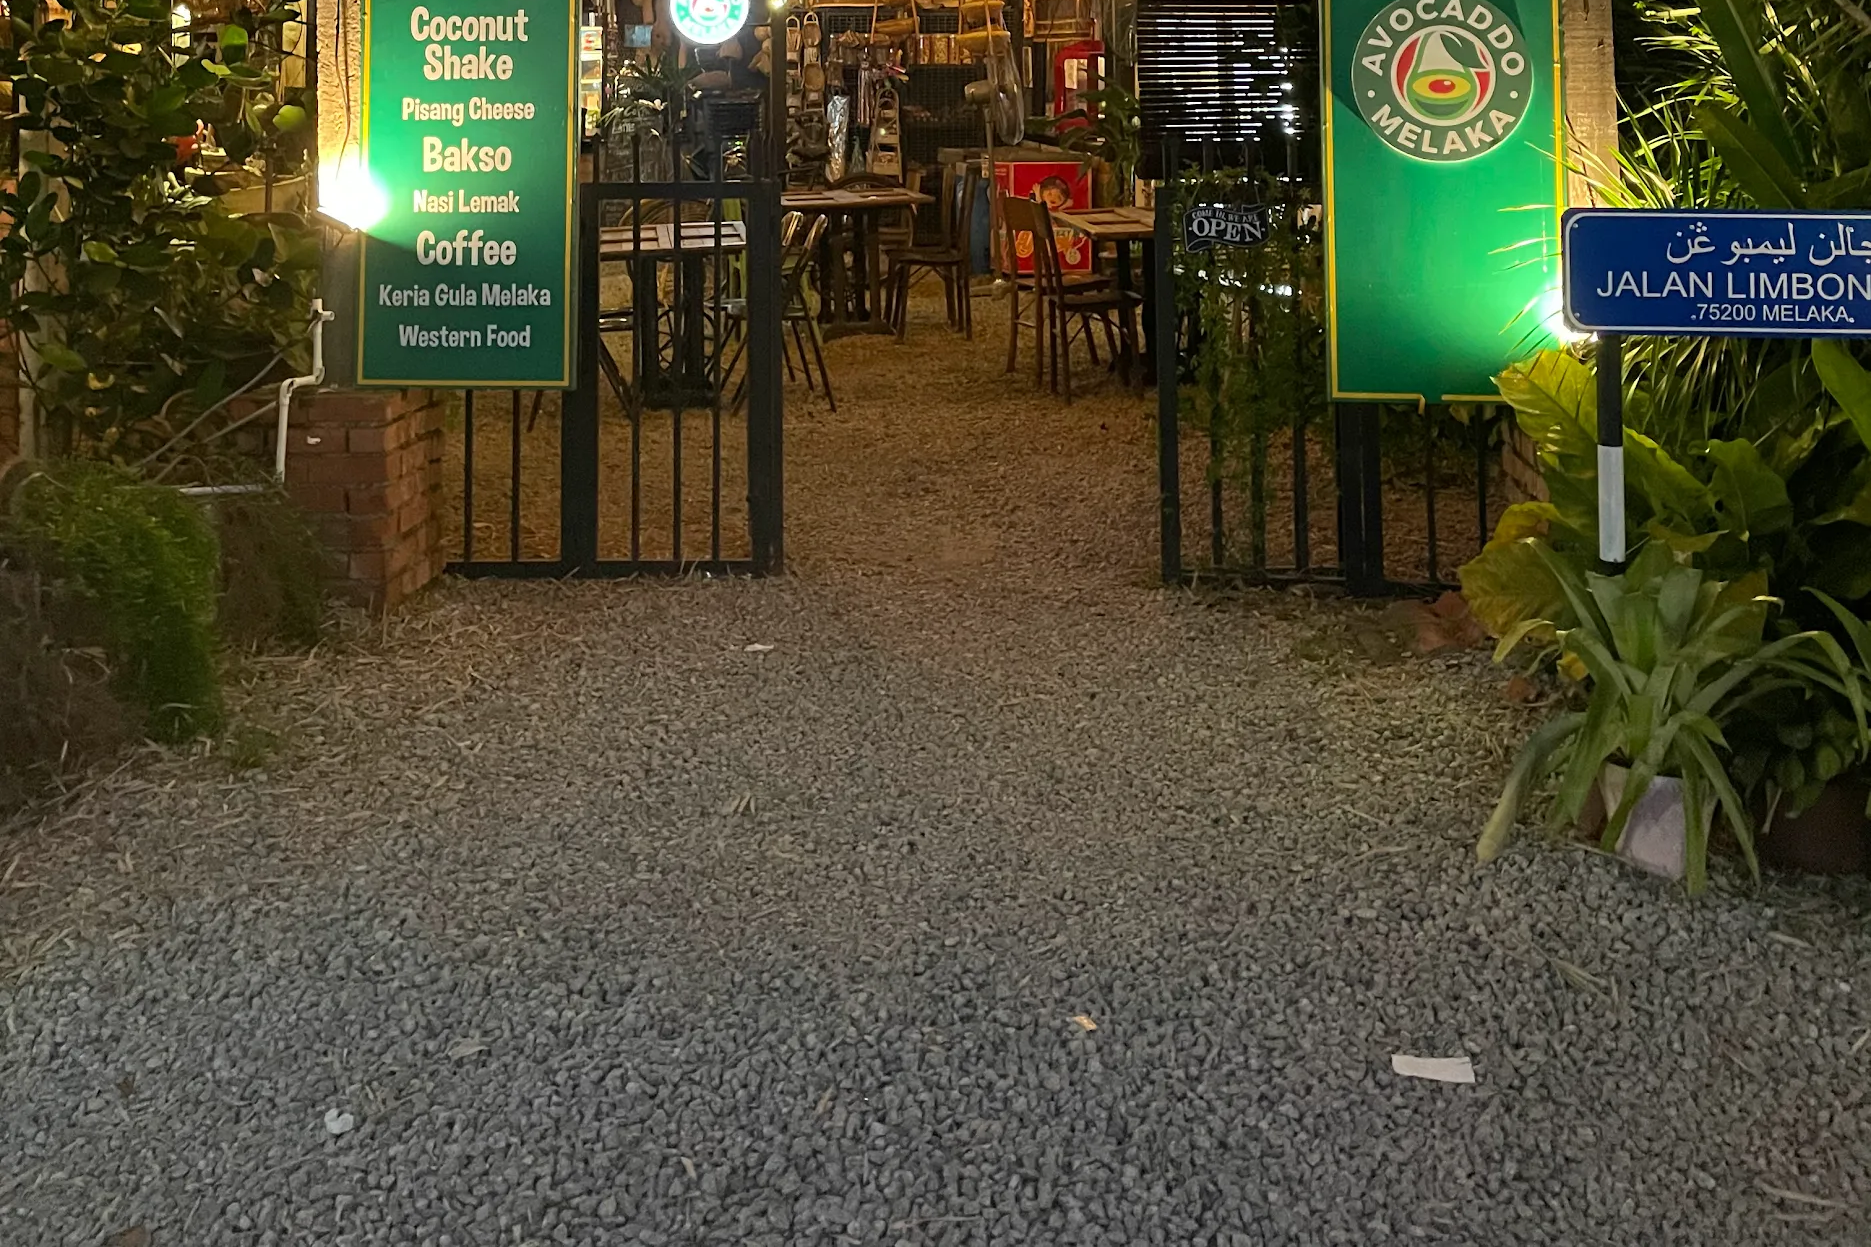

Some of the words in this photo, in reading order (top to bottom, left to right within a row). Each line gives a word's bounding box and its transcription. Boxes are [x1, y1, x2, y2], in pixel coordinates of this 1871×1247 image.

[410, 5, 529, 42] Coconut
[423, 43, 514, 81] Shake
[401, 97, 465, 128] Pisang
[468, 97, 535, 121] Cheese
[1371, 103, 1516, 155] MELAKA
[422, 136, 512, 173] Bakso
[413, 190, 454, 214] Nasi
[458, 189, 520, 214] Lemak
[1192, 217, 1262, 242] OPEN
[416, 229, 517, 266] Coffee
[378, 284, 430, 307] Keria
[434, 283, 477, 307] Gula
[481, 283, 551, 307] Melaka
[1597, 270, 1713, 298] JALAN
[1727, 272, 1871, 301] LIMBON
[1697, 304, 1756, 321] 75200
[398, 324, 481, 348] Western
[486, 324, 531, 348] Food
